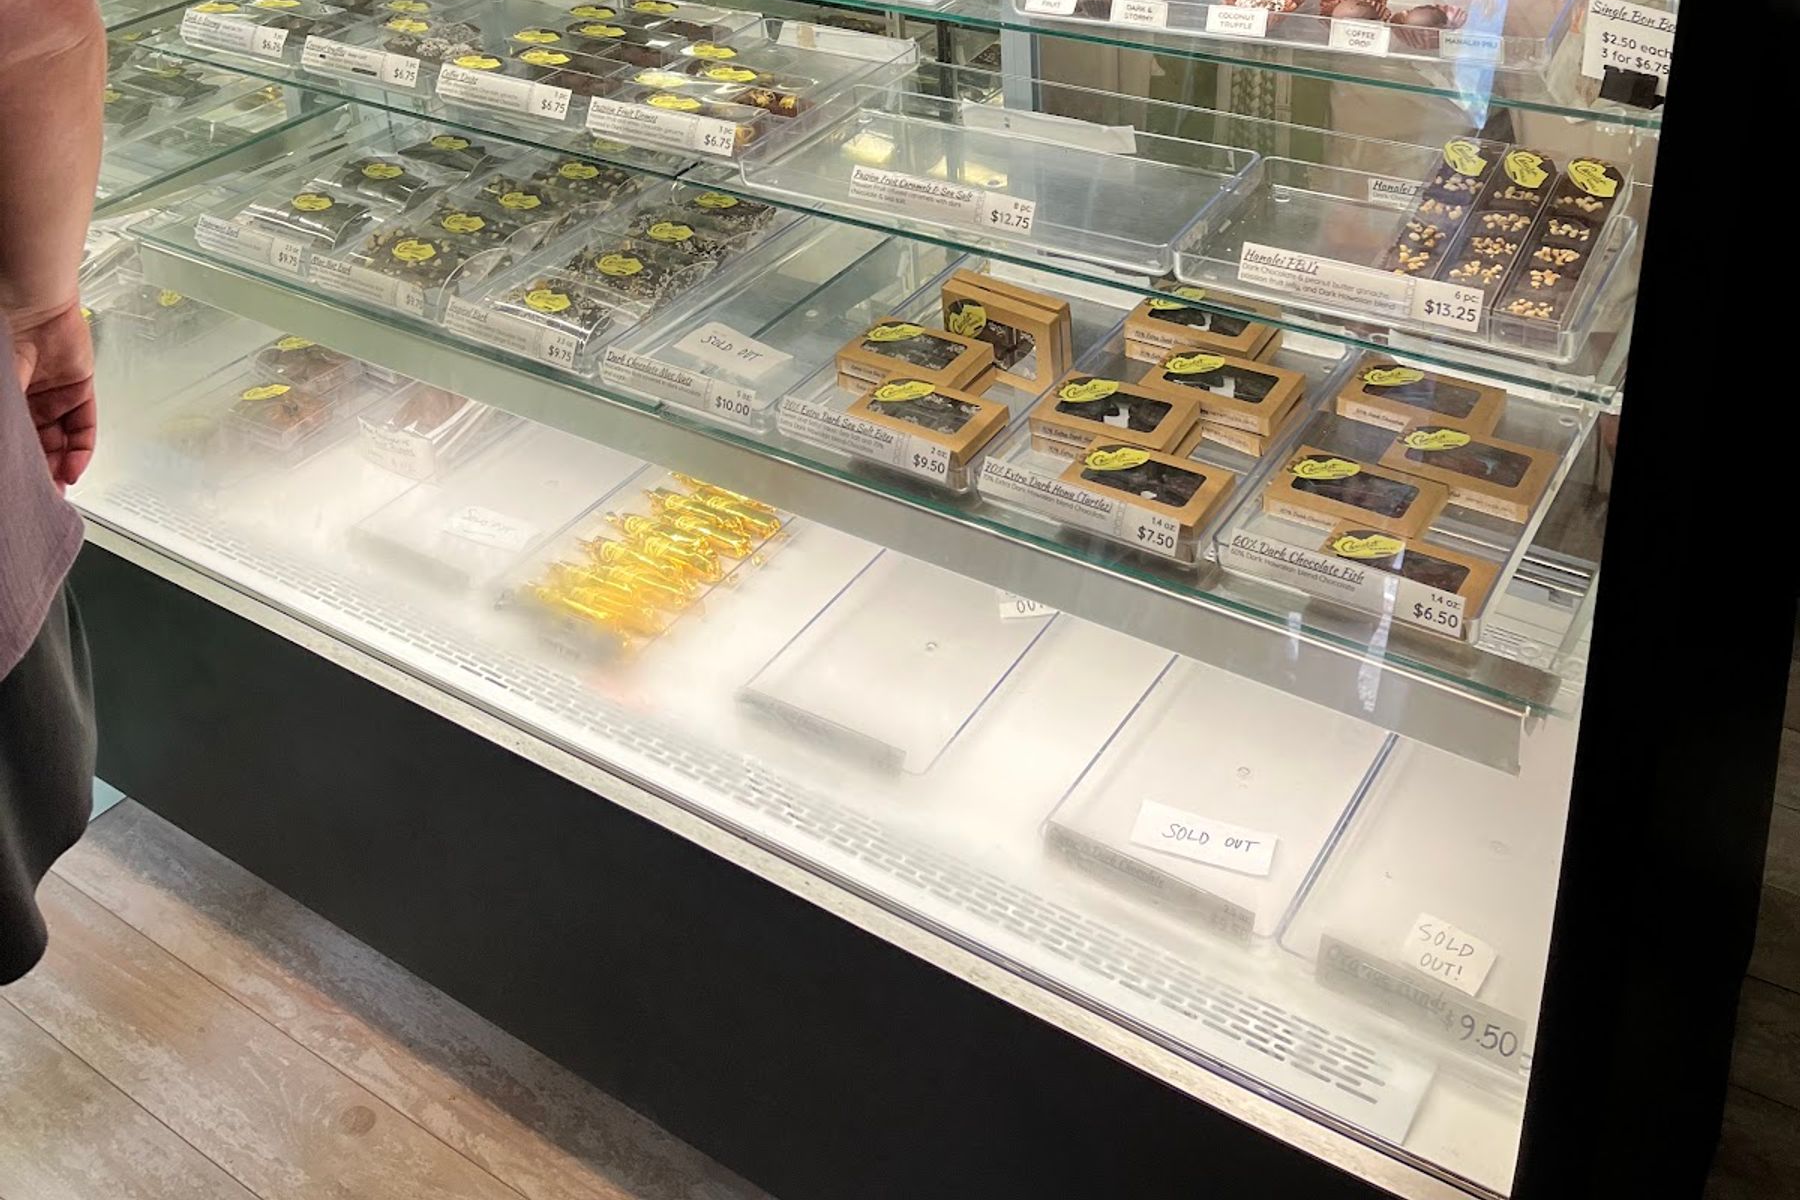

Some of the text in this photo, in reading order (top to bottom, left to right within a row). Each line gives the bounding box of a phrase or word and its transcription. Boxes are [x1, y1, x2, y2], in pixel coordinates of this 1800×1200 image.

[1041, 0, 1062, 9] FRUIT
[1126, 4, 1145, 13] DARK
[1124, 12, 1154, 22] STORMY
[1217, 11, 1256, 21] COCONUT
[1220, 21, 1253, 31] TRUFFLE
[1591, 0, 1677, 34] Single Bon Bo
[1345, 28, 1376, 40] COFFEE
[1348, 38, 1372, 48] DROP
[1601, 31, 1673, 59] $2.50 each
[1600, 47, 1671, 76] 3 for $6.75
[703, 134, 732, 150] $6.75
[1373, 180, 1413, 193] Hanalei
[990, 209, 1031, 230] $12.75
[1243, 248, 1287, 266] Hanalei
[1242, 261, 1260, 273] Dark
[1260, 264, 1297, 281] Chocolate
[1302, 285, 1317, 296] and
[1318, 287, 1337, 300] Dark
[1337, 291, 1372, 308] Hawaiian
[1373, 297, 1397, 311] blend
[1454, 290, 1462, 300] 6
[1423, 299, 1477, 323] $13.25
[548, 345, 572, 362] $9.75
[606, 350, 625, 365] Dark
[700, 334, 764, 362] SOLD OUT
[714, 395, 751, 417] $10.00
[800, 405, 822, 420] Extra
[821, 411, 843, 428] Dark
[842, 418, 859, 432] Sea
[857, 422, 876, 437] Salt
[912, 453, 946, 475] $9.50
[984, 461, 1004, 477] 70%
[1004, 467, 1028, 484] Extra
[1028, 473, 1052, 493] Dark
[1075, 488, 1113, 514] (Turtles)
[1151, 516, 1163, 527] 1.4
[1137, 525, 1175, 549] $7.50
[1231, 535, 1366, 585] 60% Dark Chocolate Fish
[1245, 552, 1263, 564] Dark
[1263, 557, 1296, 575] Hawaiian
[1296, 567, 1318, 582] blend
[1318, 573, 1356, 593] Chocolate
[1430, 592, 1444, 605] 1.4
[1412, 601, 1459, 629] $6.50
[1161, 822, 1261, 853] SOLD OUT
[1418, 923, 1475, 958] SOLD
[1419, 952, 1464, 982] OUT!
